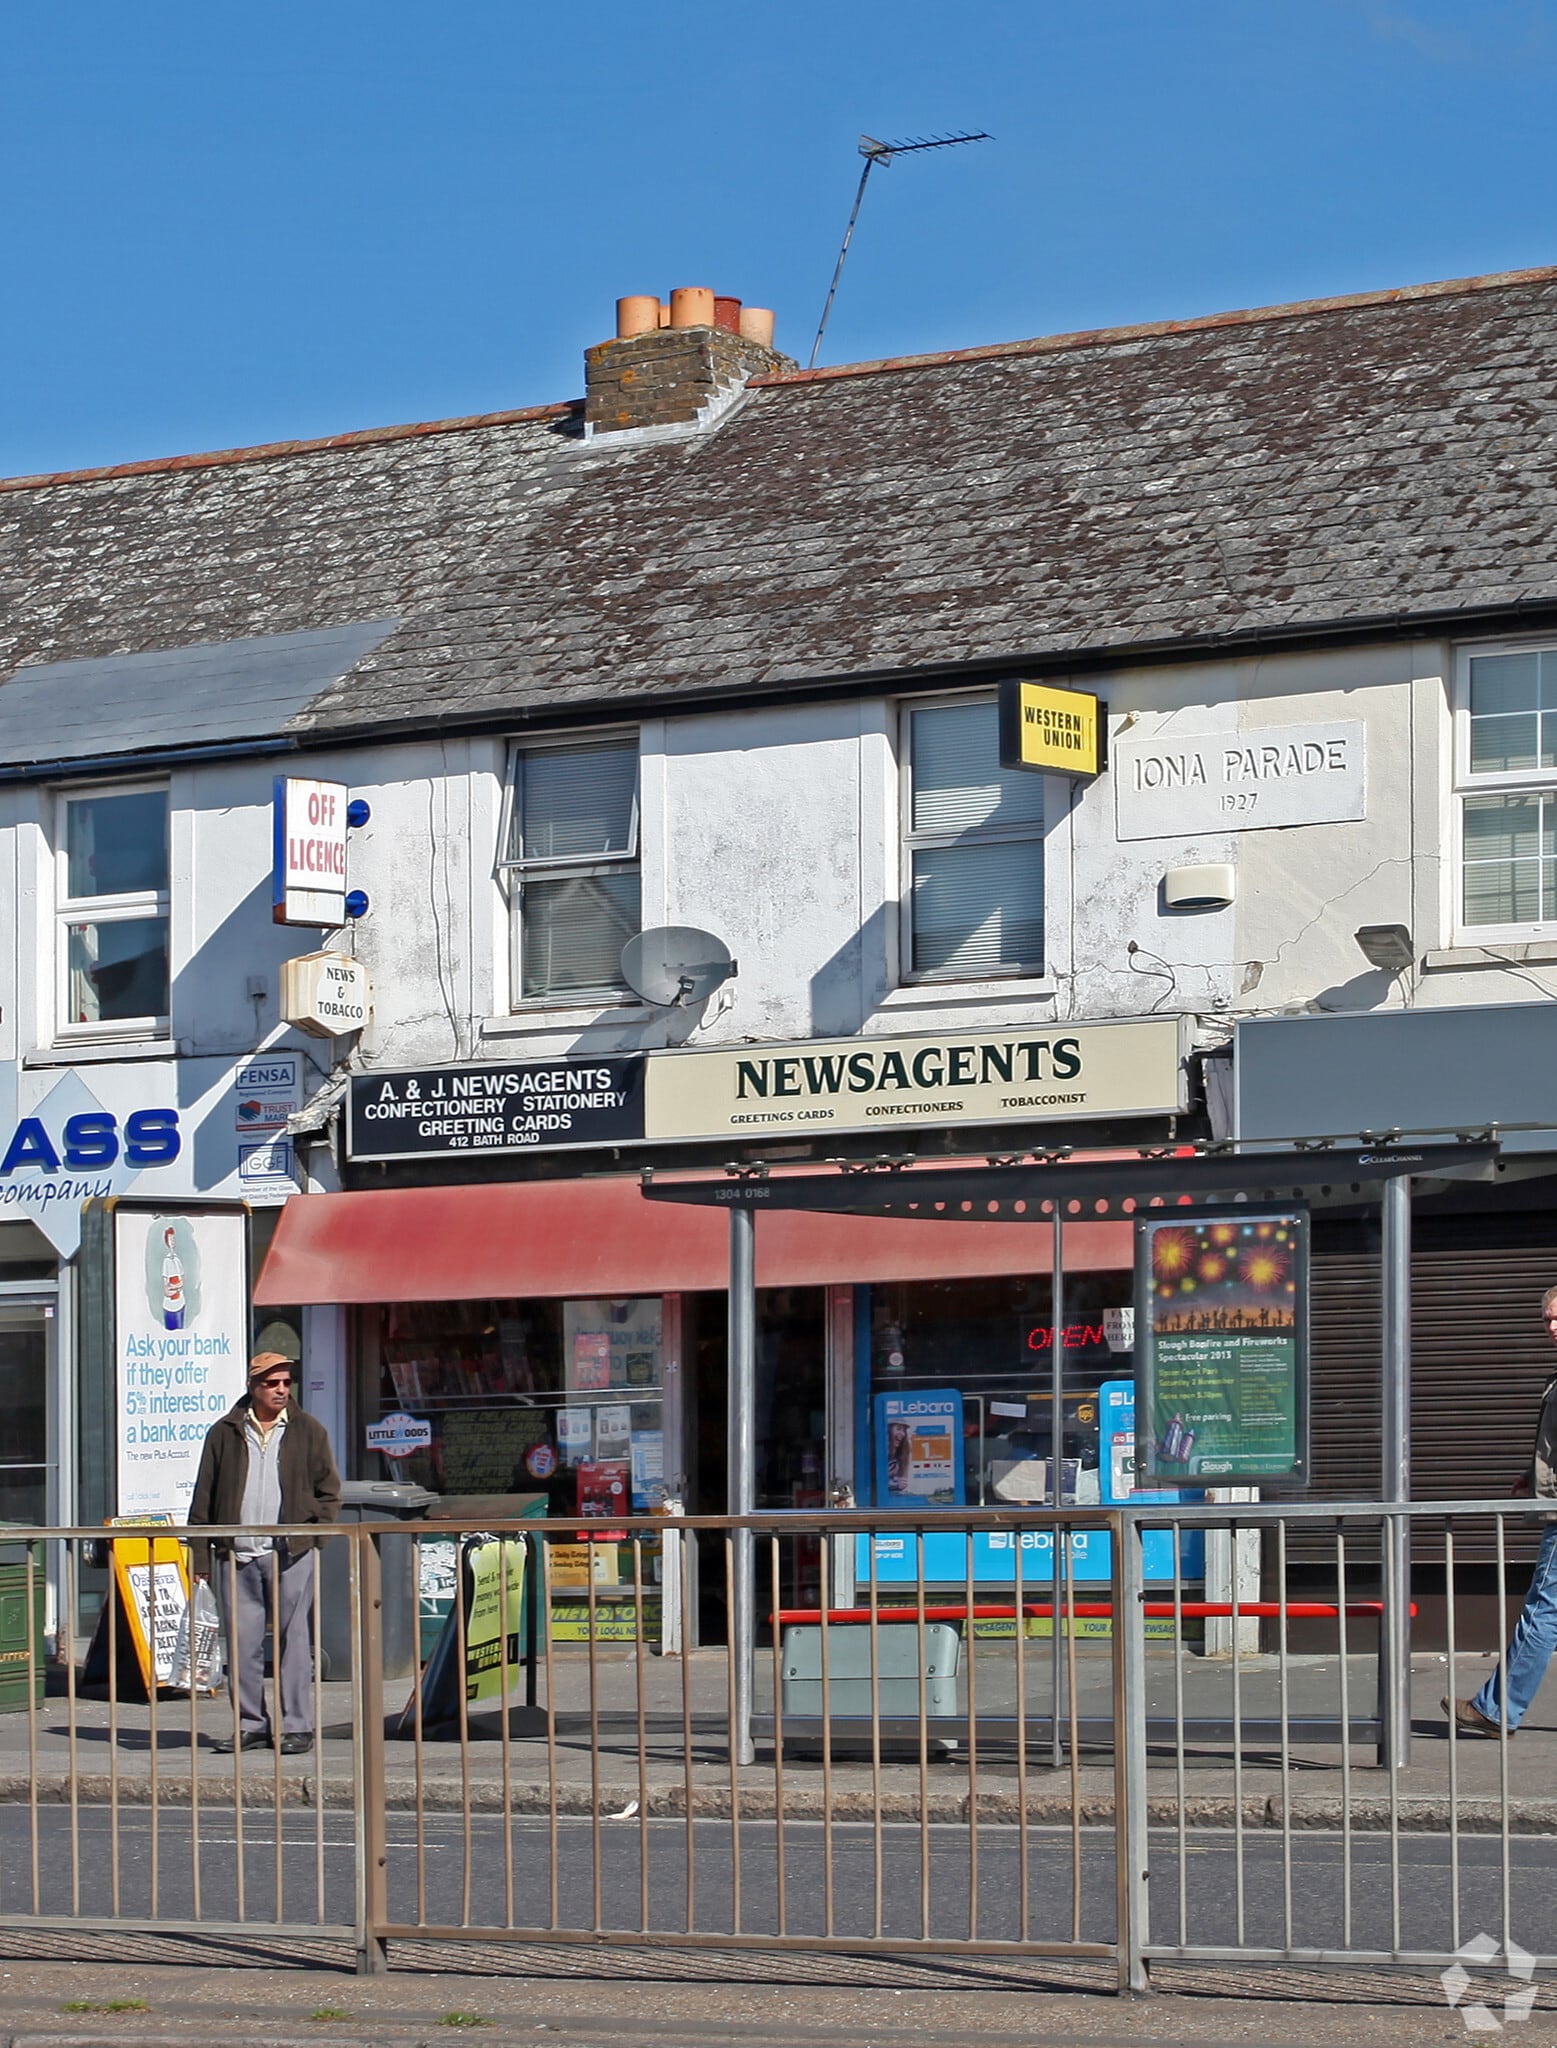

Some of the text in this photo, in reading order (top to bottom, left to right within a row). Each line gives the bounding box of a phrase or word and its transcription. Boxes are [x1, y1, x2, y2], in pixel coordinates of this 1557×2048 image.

[1024, 706, 1081, 731] WESTERN
[1043, 729, 1081, 750] UNION
[1134, 740, 1347, 792] IONA PARADE
[308, 793, 335, 826] OFF
[1219, 793, 1258, 811] 1927
[289, 838, 345, 874] LICENCE
[326, 967, 355, 983] NEWS
[337, 986, 345, 998] &
[318, 1001, 363, 1019] TOBACCO
[240, 1069, 290, 1083] FENSA
[736, 1039, 1082, 1099] NEWSAGENTS
[405, 1080, 421, 1100] &
[452, 1068, 612, 1097] NEWSAGENTS
[263, 1104, 292, 1113] TRUST
[364, 1091, 626, 1119] CONFECTIONERY STATIONERY
[730, 1092, 1086, 1124] GREETINGS CARDS CONFECTIONERS TOBACCONIST
[418, 1113, 572, 1137] GREETING CARDS
[449, 1132, 540, 1147] 412 BATH ROAD
[249, 1156, 283, 1170] GGF
[715, 1188, 740, 1200] 1304
[126, 1333, 231, 1361] Ask your bank
[1158, 1336, 1288, 1351] Slough Bonfire and Fireworks
[1158, 1351, 1232, 1363] Spectacular 2013
[126, 1361, 209, 1389] if they offer
[150, 1391, 205, 1414] interest
[207, 1393, 227, 1412] on
[900, 1400, 955, 1414] Lebara
[1185, 1413, 1202, 1422] Free
[1202, 1412, 1232, 1422] parking
[126, 1426, 137, 1443] a
[140, 1420, 177, 1443] bank
[1008, 1532, 1088, 1549] Leba
[132, 1573, 177, 1587] OBSVER
[577, 1626, 600, 1635] YOR
[601, 1626, 624, 1636] LOCAL
[1083, 1623, 1107, 1633] YOUR
